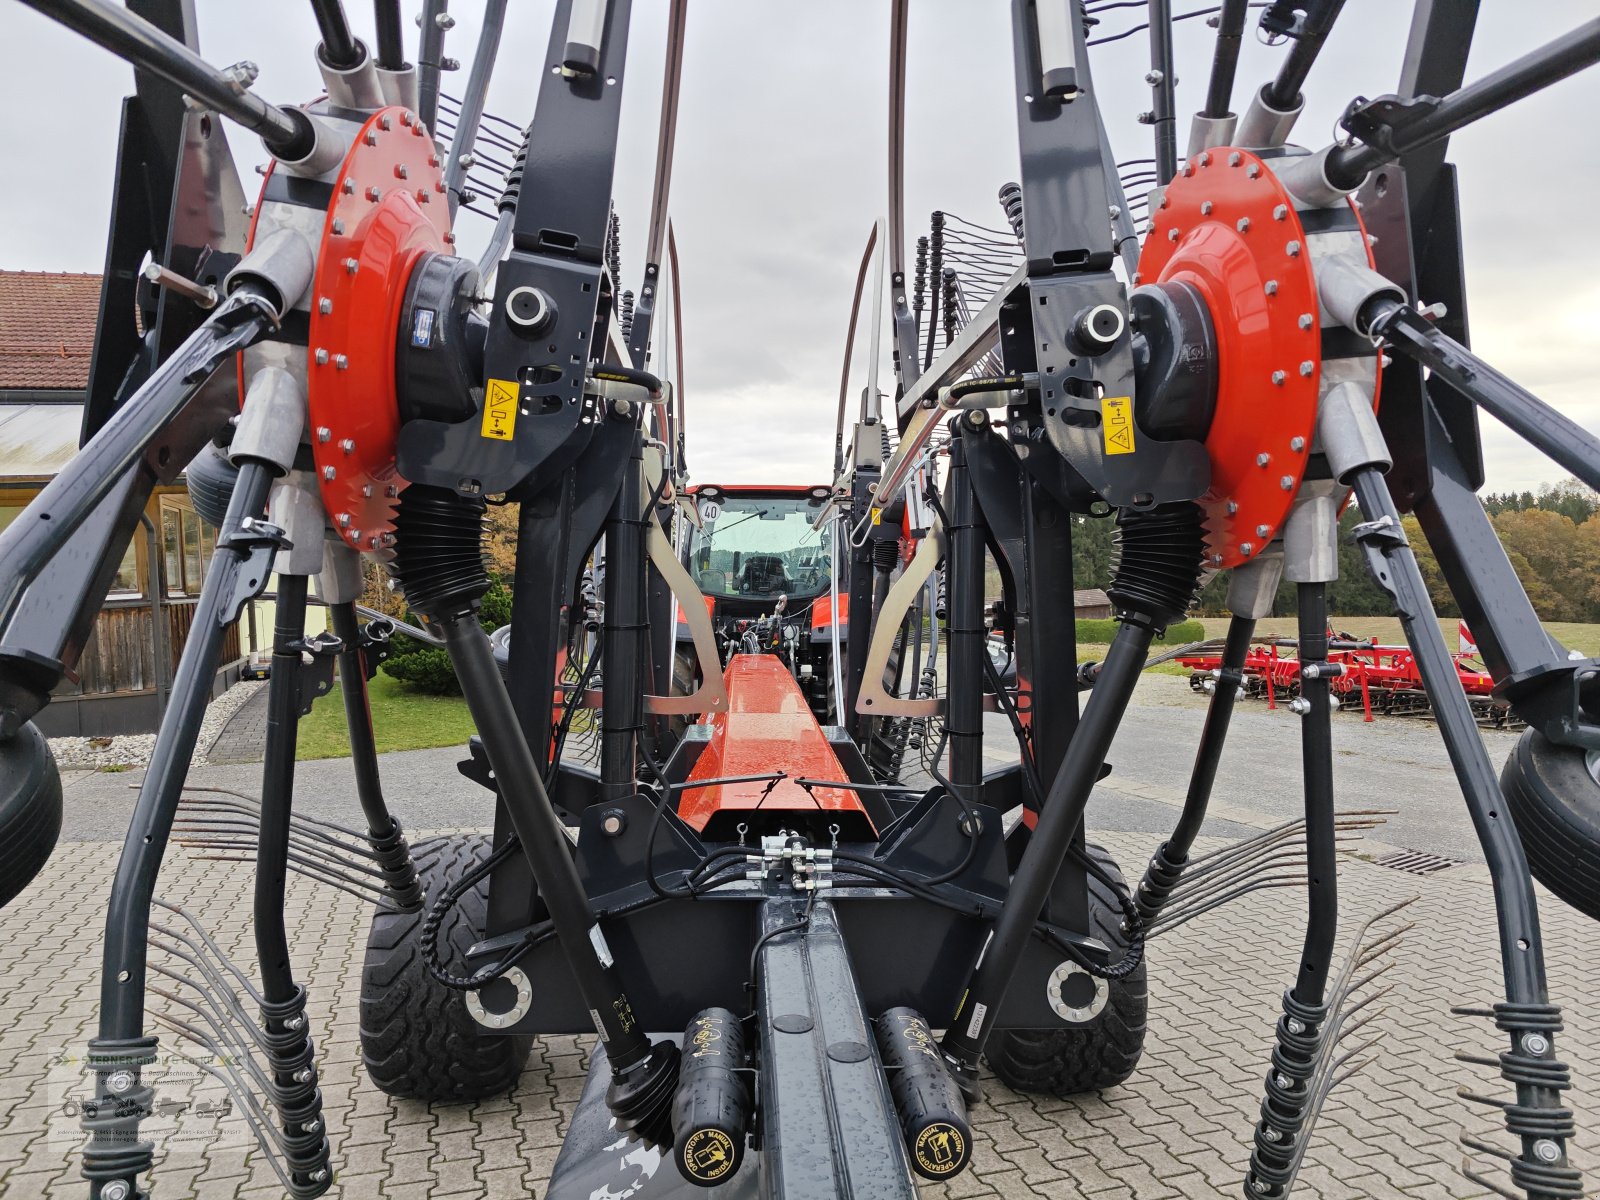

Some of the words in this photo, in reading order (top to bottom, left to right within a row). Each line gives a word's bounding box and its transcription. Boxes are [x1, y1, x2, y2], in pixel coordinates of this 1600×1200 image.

[704, 506, 717, 519] 40
[918, 1126, 939, 1148] MANUAL
[949, 1129, 962, 1153] INSIDE
[687, 1132, 705, 1172] OPERATOR'S
[708, 1131, 731, 1150] MANUAL
[919, 1151, 954, 1171] OPERATOR'S
[707, 1160, 730, 1177] INSIDE
